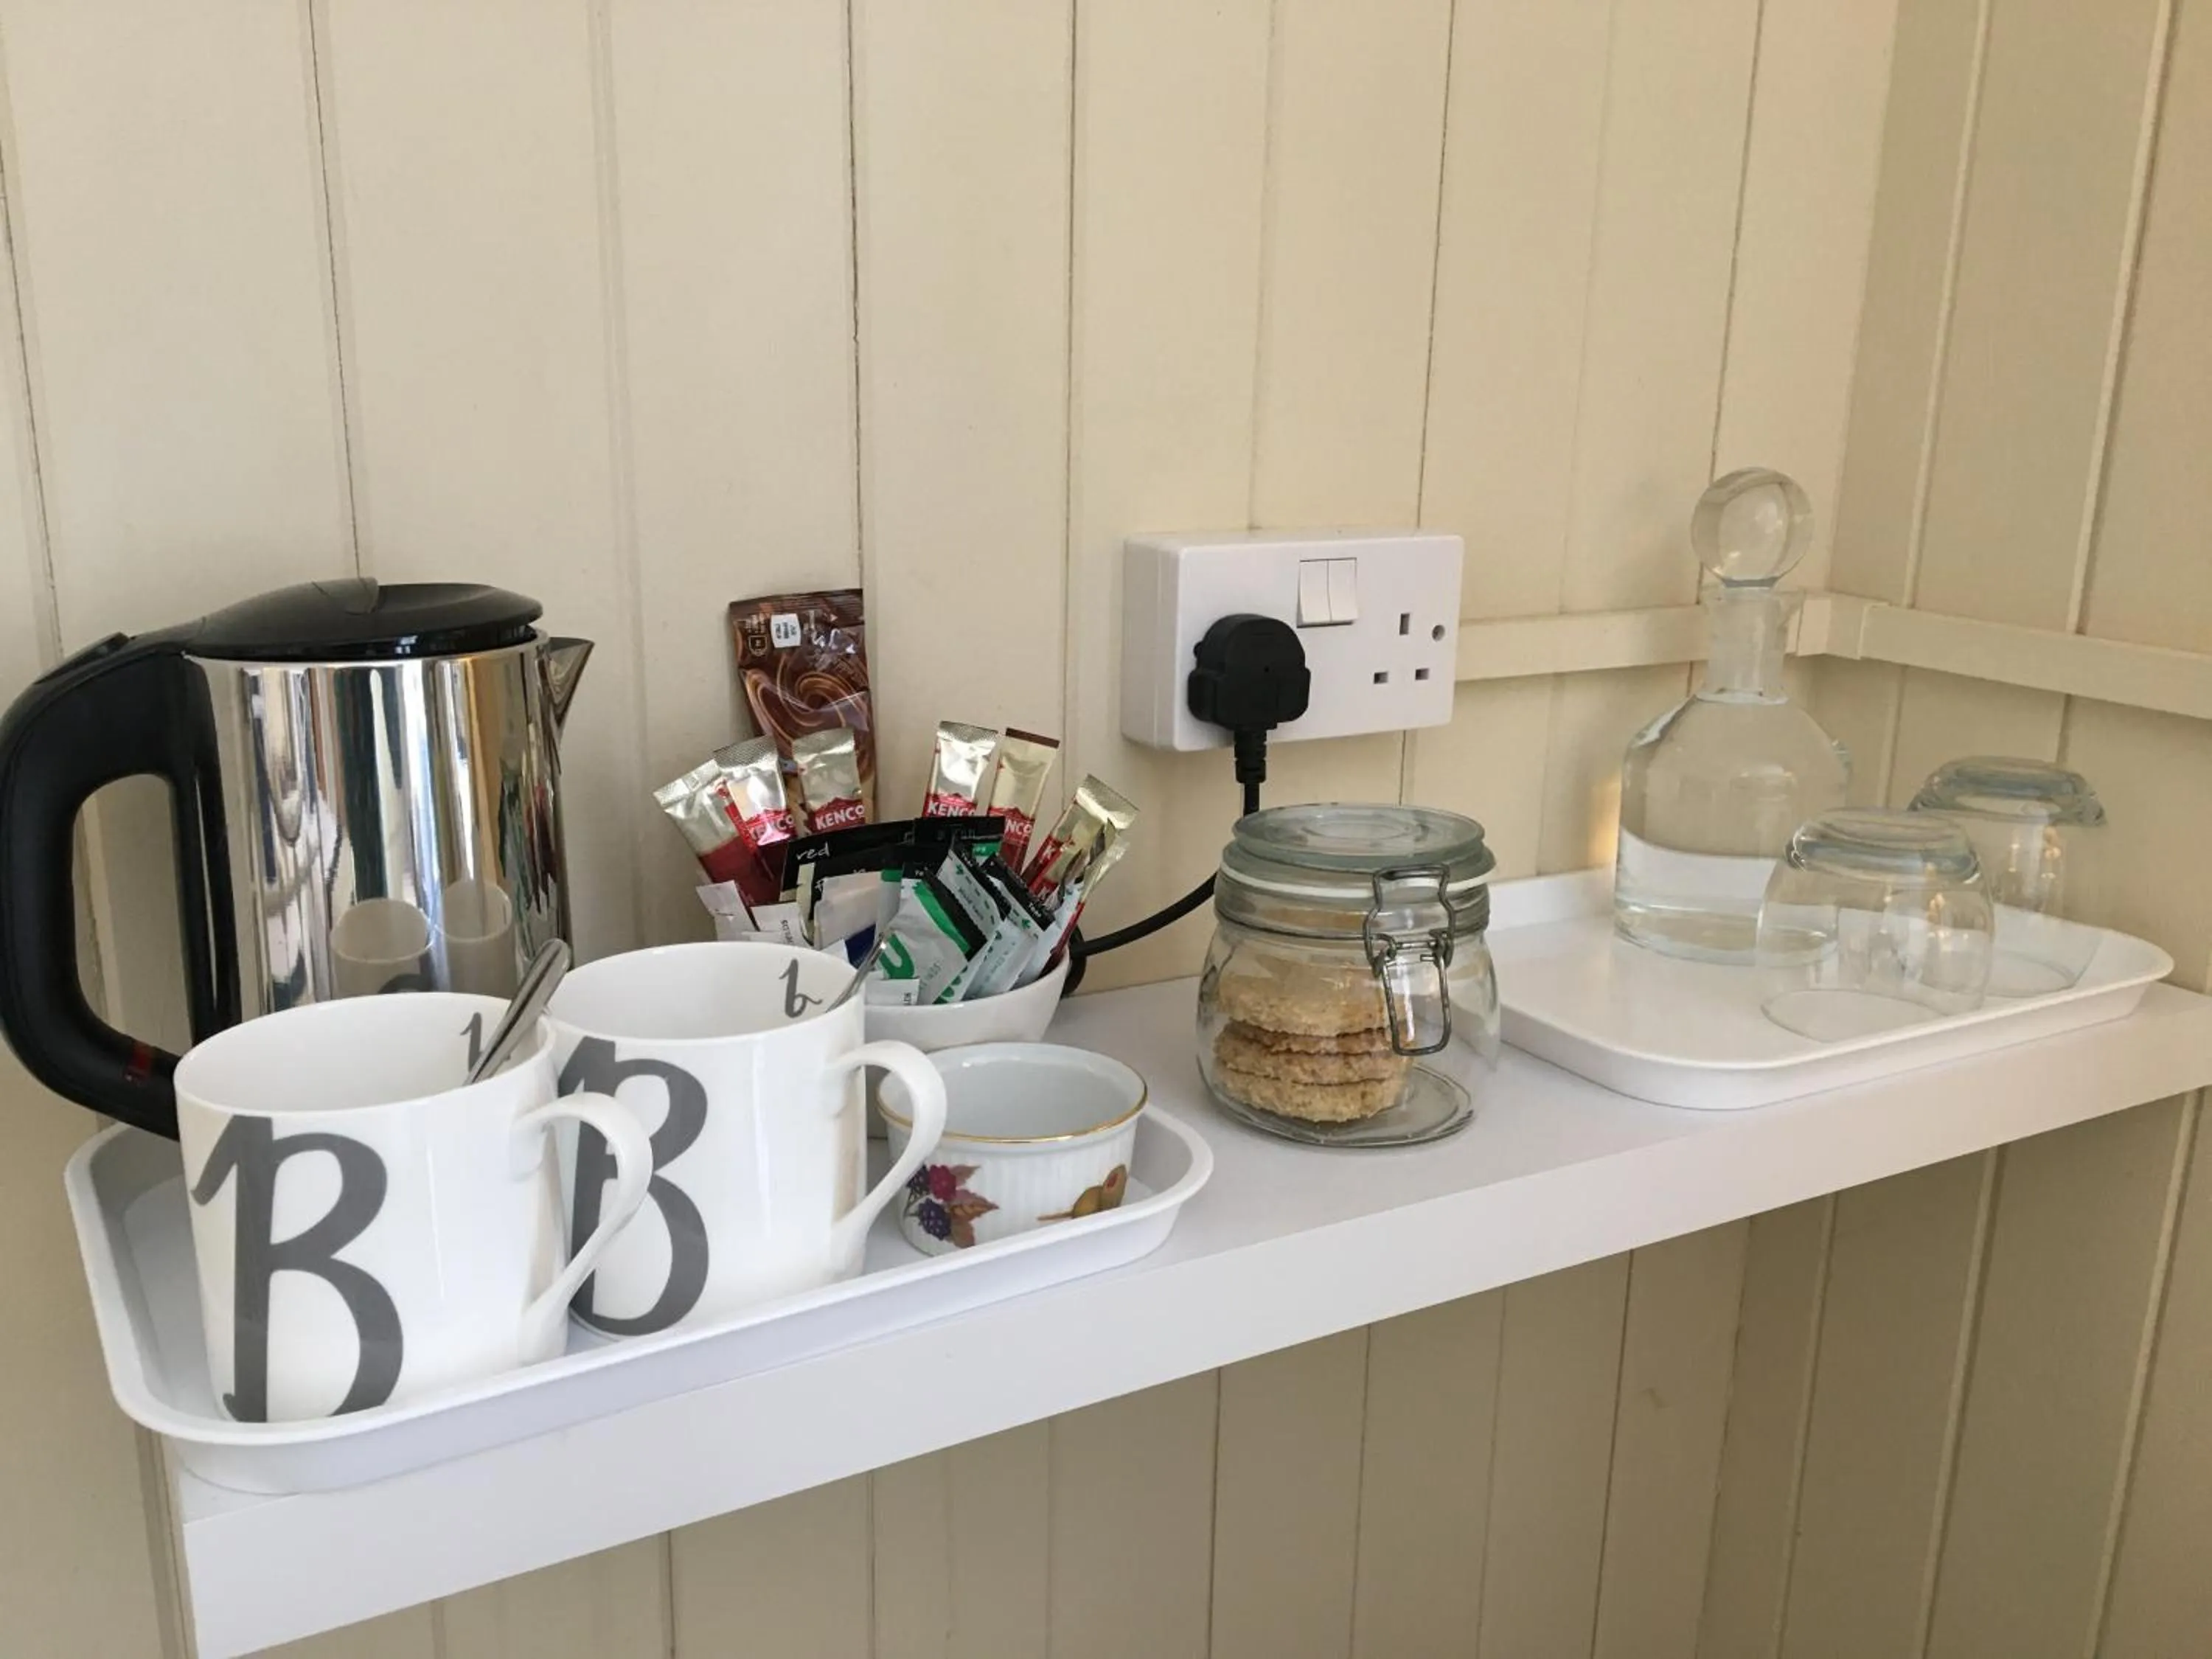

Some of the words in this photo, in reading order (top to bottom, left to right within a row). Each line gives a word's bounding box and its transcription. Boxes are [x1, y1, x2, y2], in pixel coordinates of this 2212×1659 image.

[815, 804, 865, 831] KENCO
[1004, 821, 1032, 836] NCO
[796, 841, 830, 861] red
[557, 1036, 710, 1336] B
[190, 1114, 403, 1423] B
